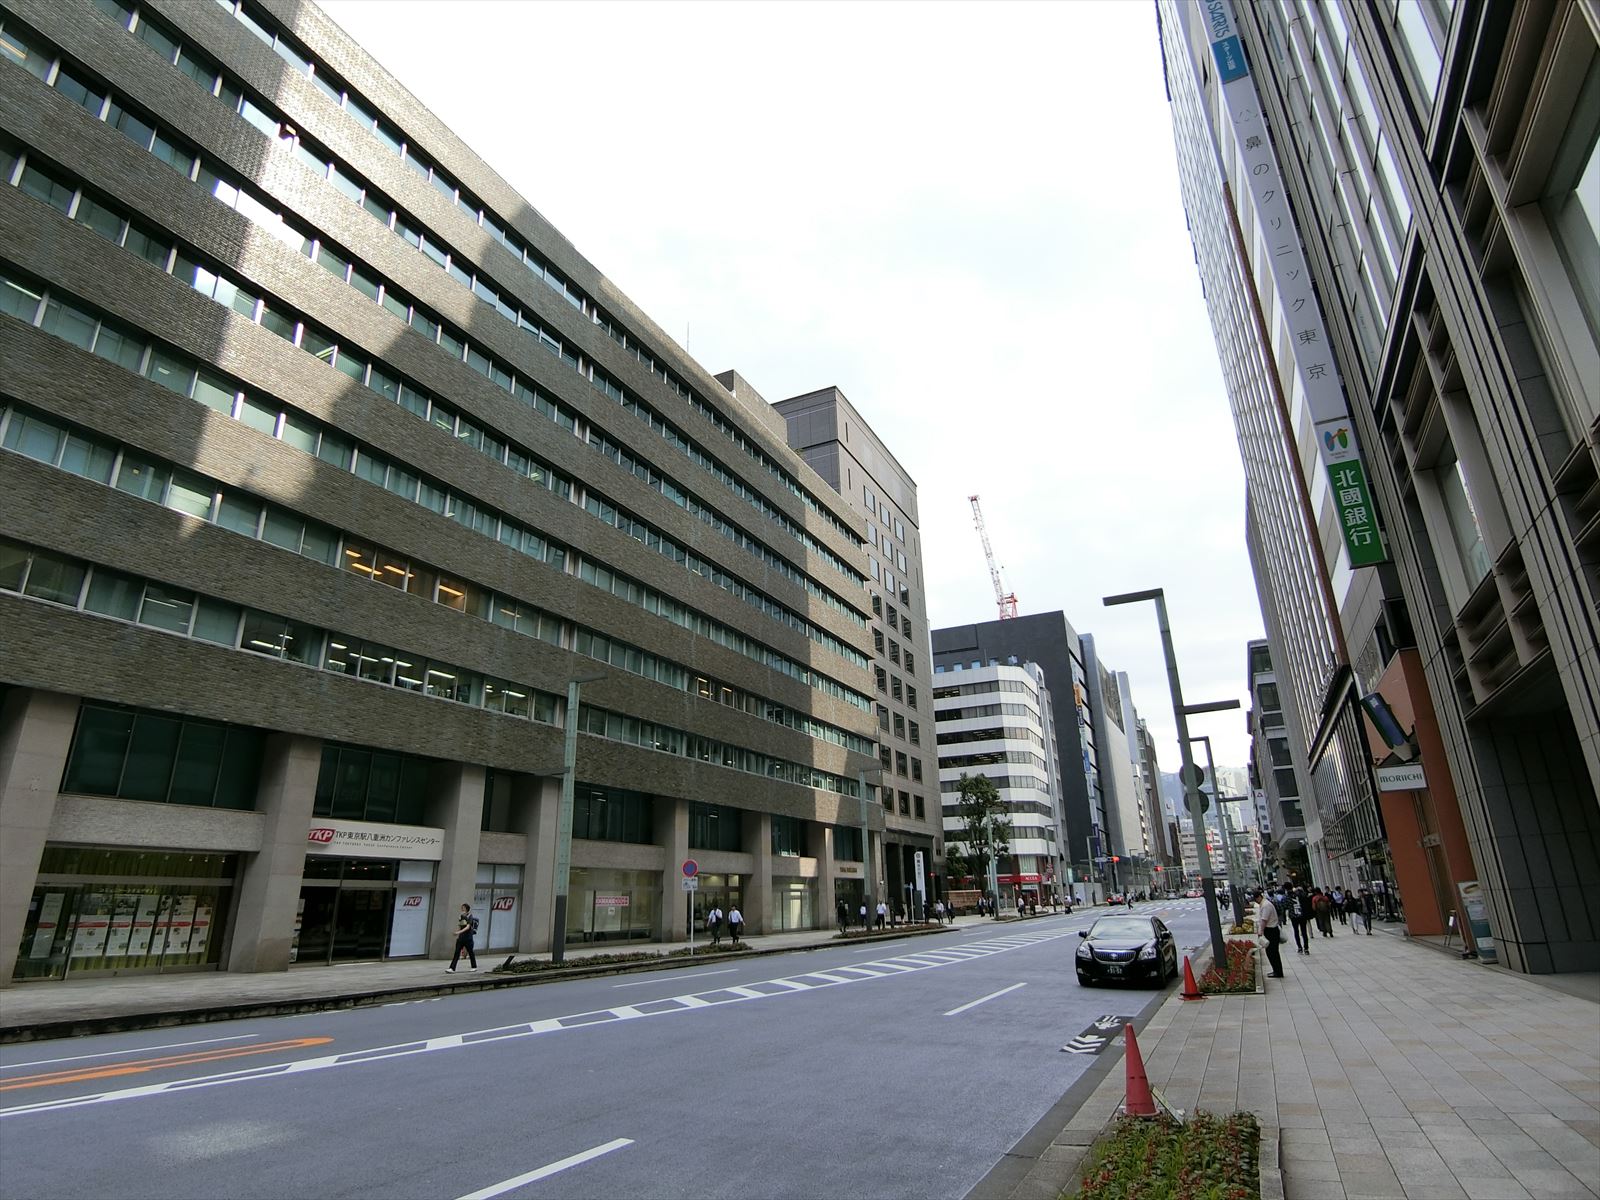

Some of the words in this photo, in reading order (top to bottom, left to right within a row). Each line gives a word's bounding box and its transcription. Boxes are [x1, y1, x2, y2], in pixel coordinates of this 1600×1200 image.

[1208, 2, 1230, 38] STARTS
[1334, 469, 1372, 547] 北國銀行
[1380, 773, 1423, 783] MORIICHI
[308, 830, 333, 841] TKP
[405, 897, 421, 906] TKP
[493, 898, 513, 911] TKP
